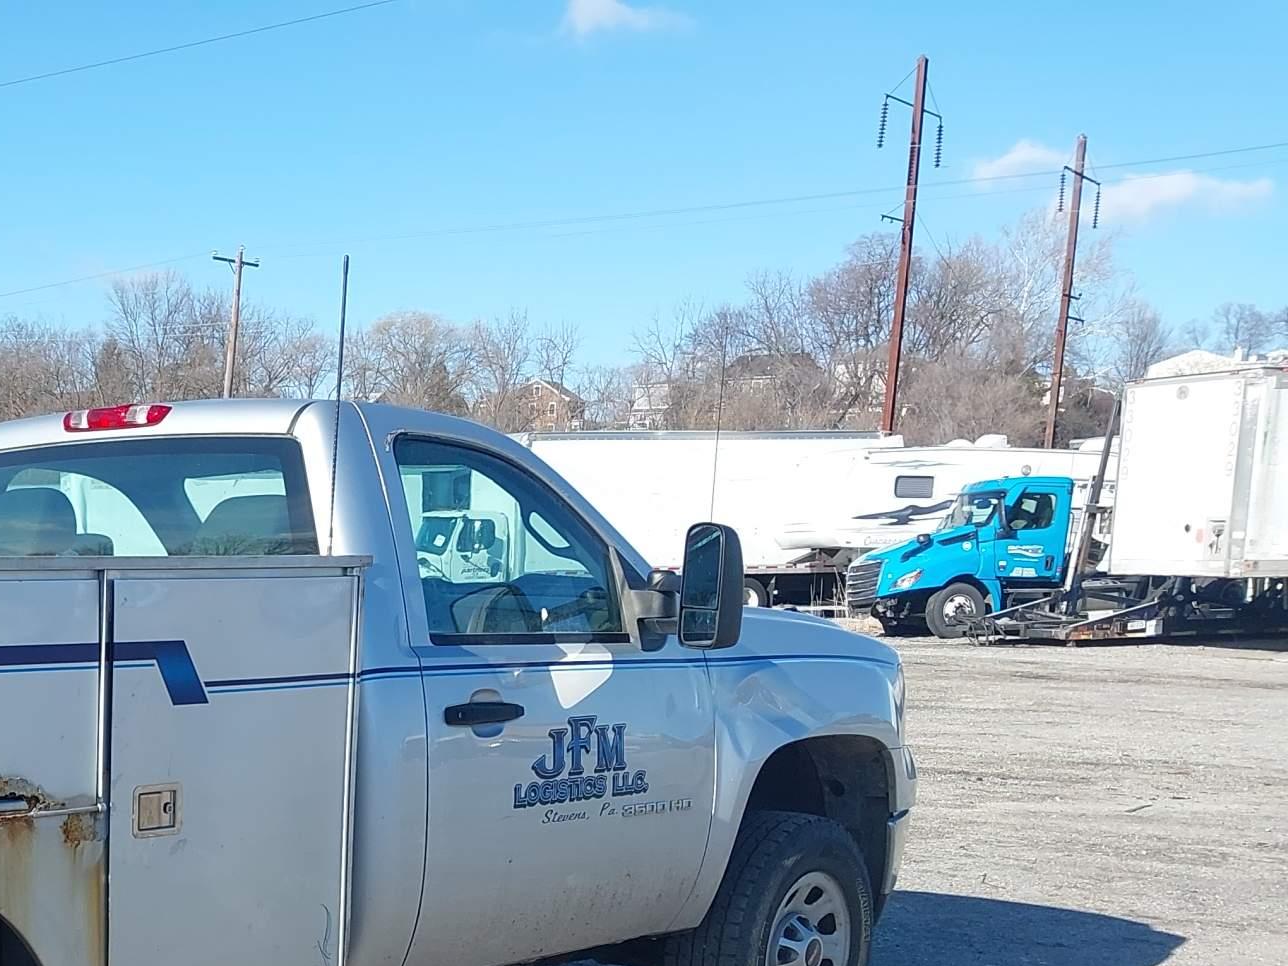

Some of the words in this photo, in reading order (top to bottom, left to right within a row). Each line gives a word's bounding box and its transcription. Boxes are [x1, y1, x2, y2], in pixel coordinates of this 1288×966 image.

[531, 715, 628, 780] JFM
[513, 775, 608, 809] LOGISTICS
[621, 801, 667, 818] 3500
[668, 799, 693, 814] HD
